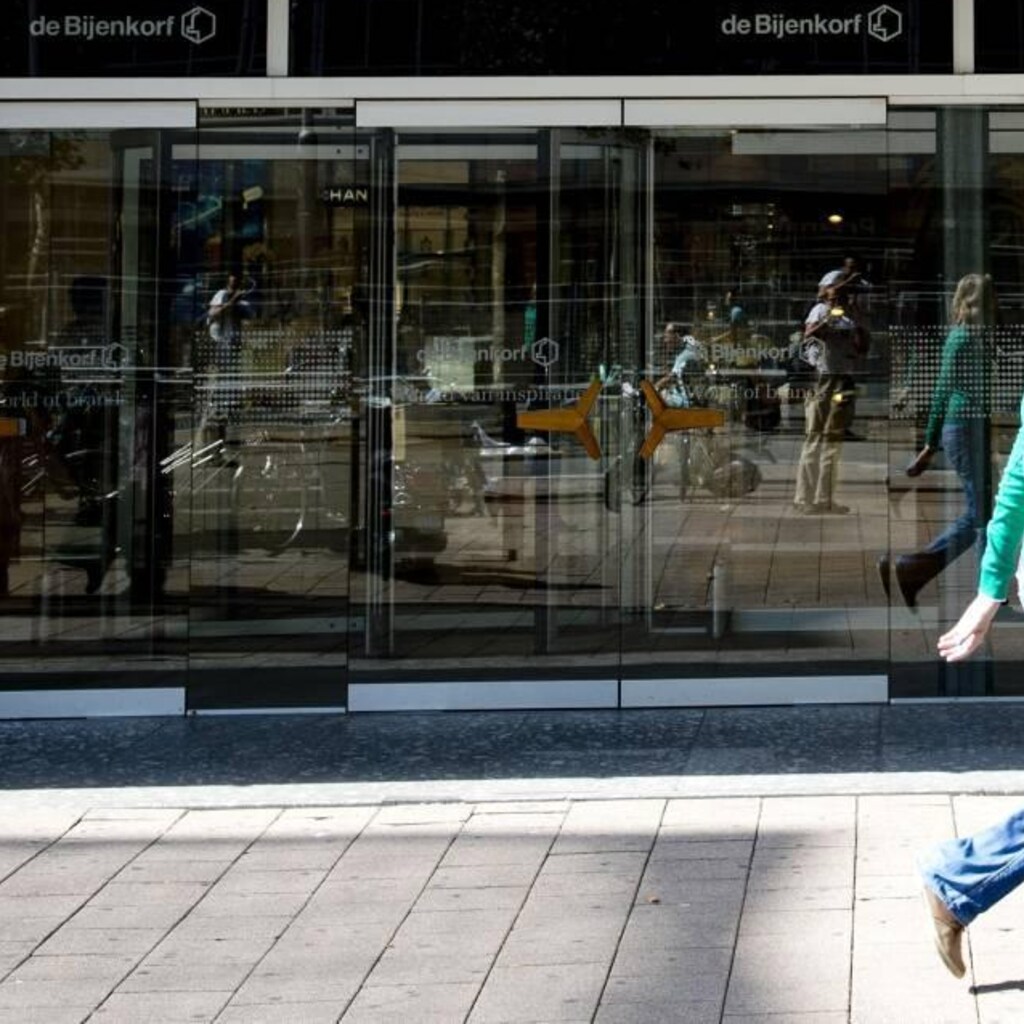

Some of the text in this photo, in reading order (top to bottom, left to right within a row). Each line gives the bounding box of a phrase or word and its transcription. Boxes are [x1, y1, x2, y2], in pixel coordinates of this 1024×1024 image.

[29, 15, 174, 40] de Bijenkorf
[721, 13, 862, 39] de Bijenkorf
